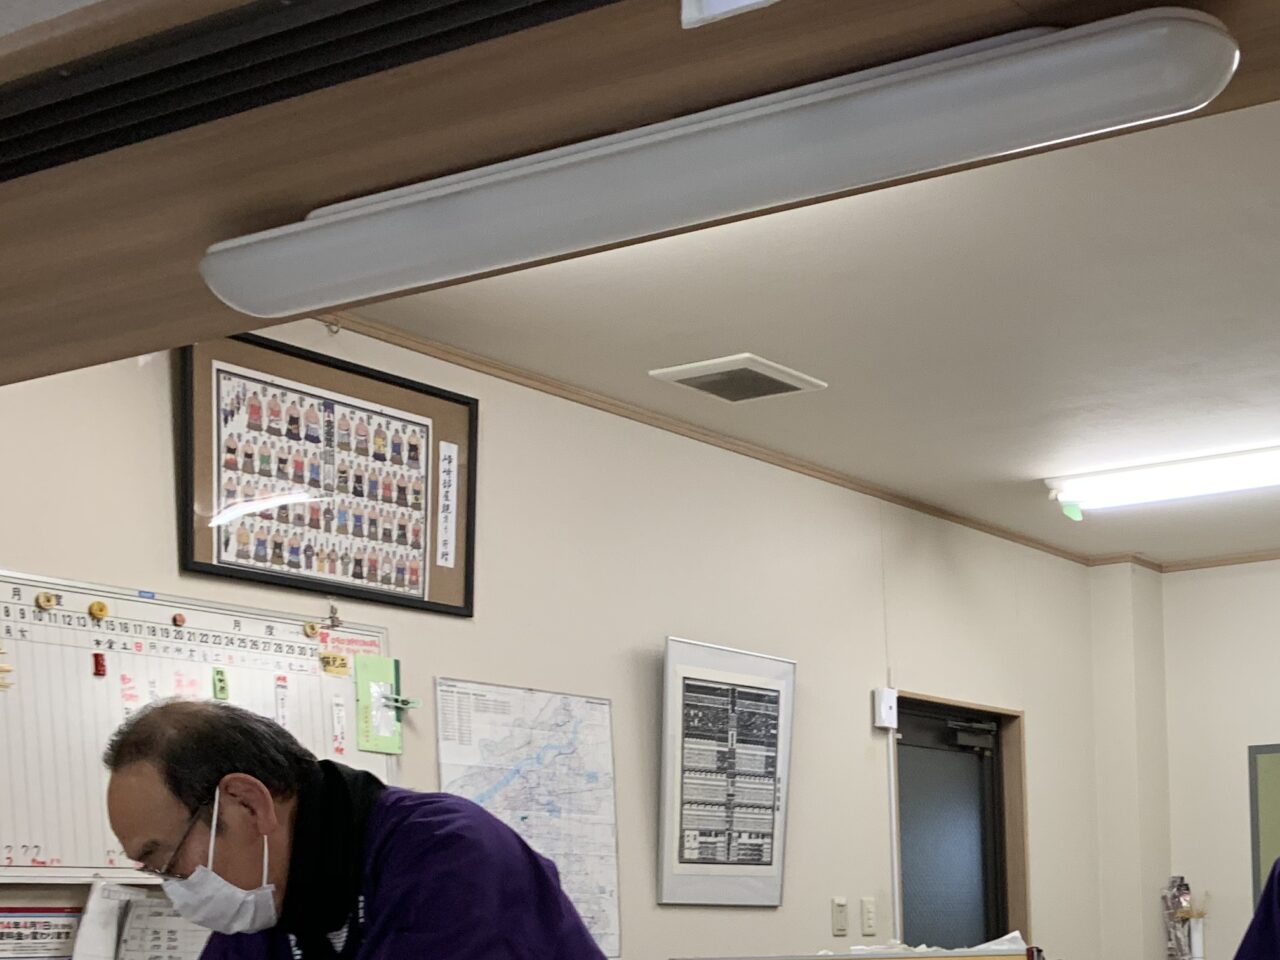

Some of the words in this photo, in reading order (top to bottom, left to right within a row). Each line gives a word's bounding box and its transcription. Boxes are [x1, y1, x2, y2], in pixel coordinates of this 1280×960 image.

[4, 606, 10, 617] 8
[20, 608, 26, 619] 9
[48, 613, 57, 623] 11
[62, 615, 73, 625] 12
[76, 616, 87, 627] 13
[105, 620, 115, 631] 15
[119, 622, 129, 633] 16
[133, 624, 143, 635] 17
[146, 626, 156, 636] 18
[160, 628, 170, 638] 19
[173, 629, 184, 640] 20
[187, 631, 196, 641] 21
[199, 633, 209, 643] 22
[212, 634, 221, 645] 23
[224, 636, 234, 646] 24
[237, 638, 247, 648] 25
[250, 639, 259, 650] 26
[262, 641, 271, 651] 27
[274, 642, 283, 653] 28
[286, 644, 295, 655] 29
[297, 646, 307, 656] 30
